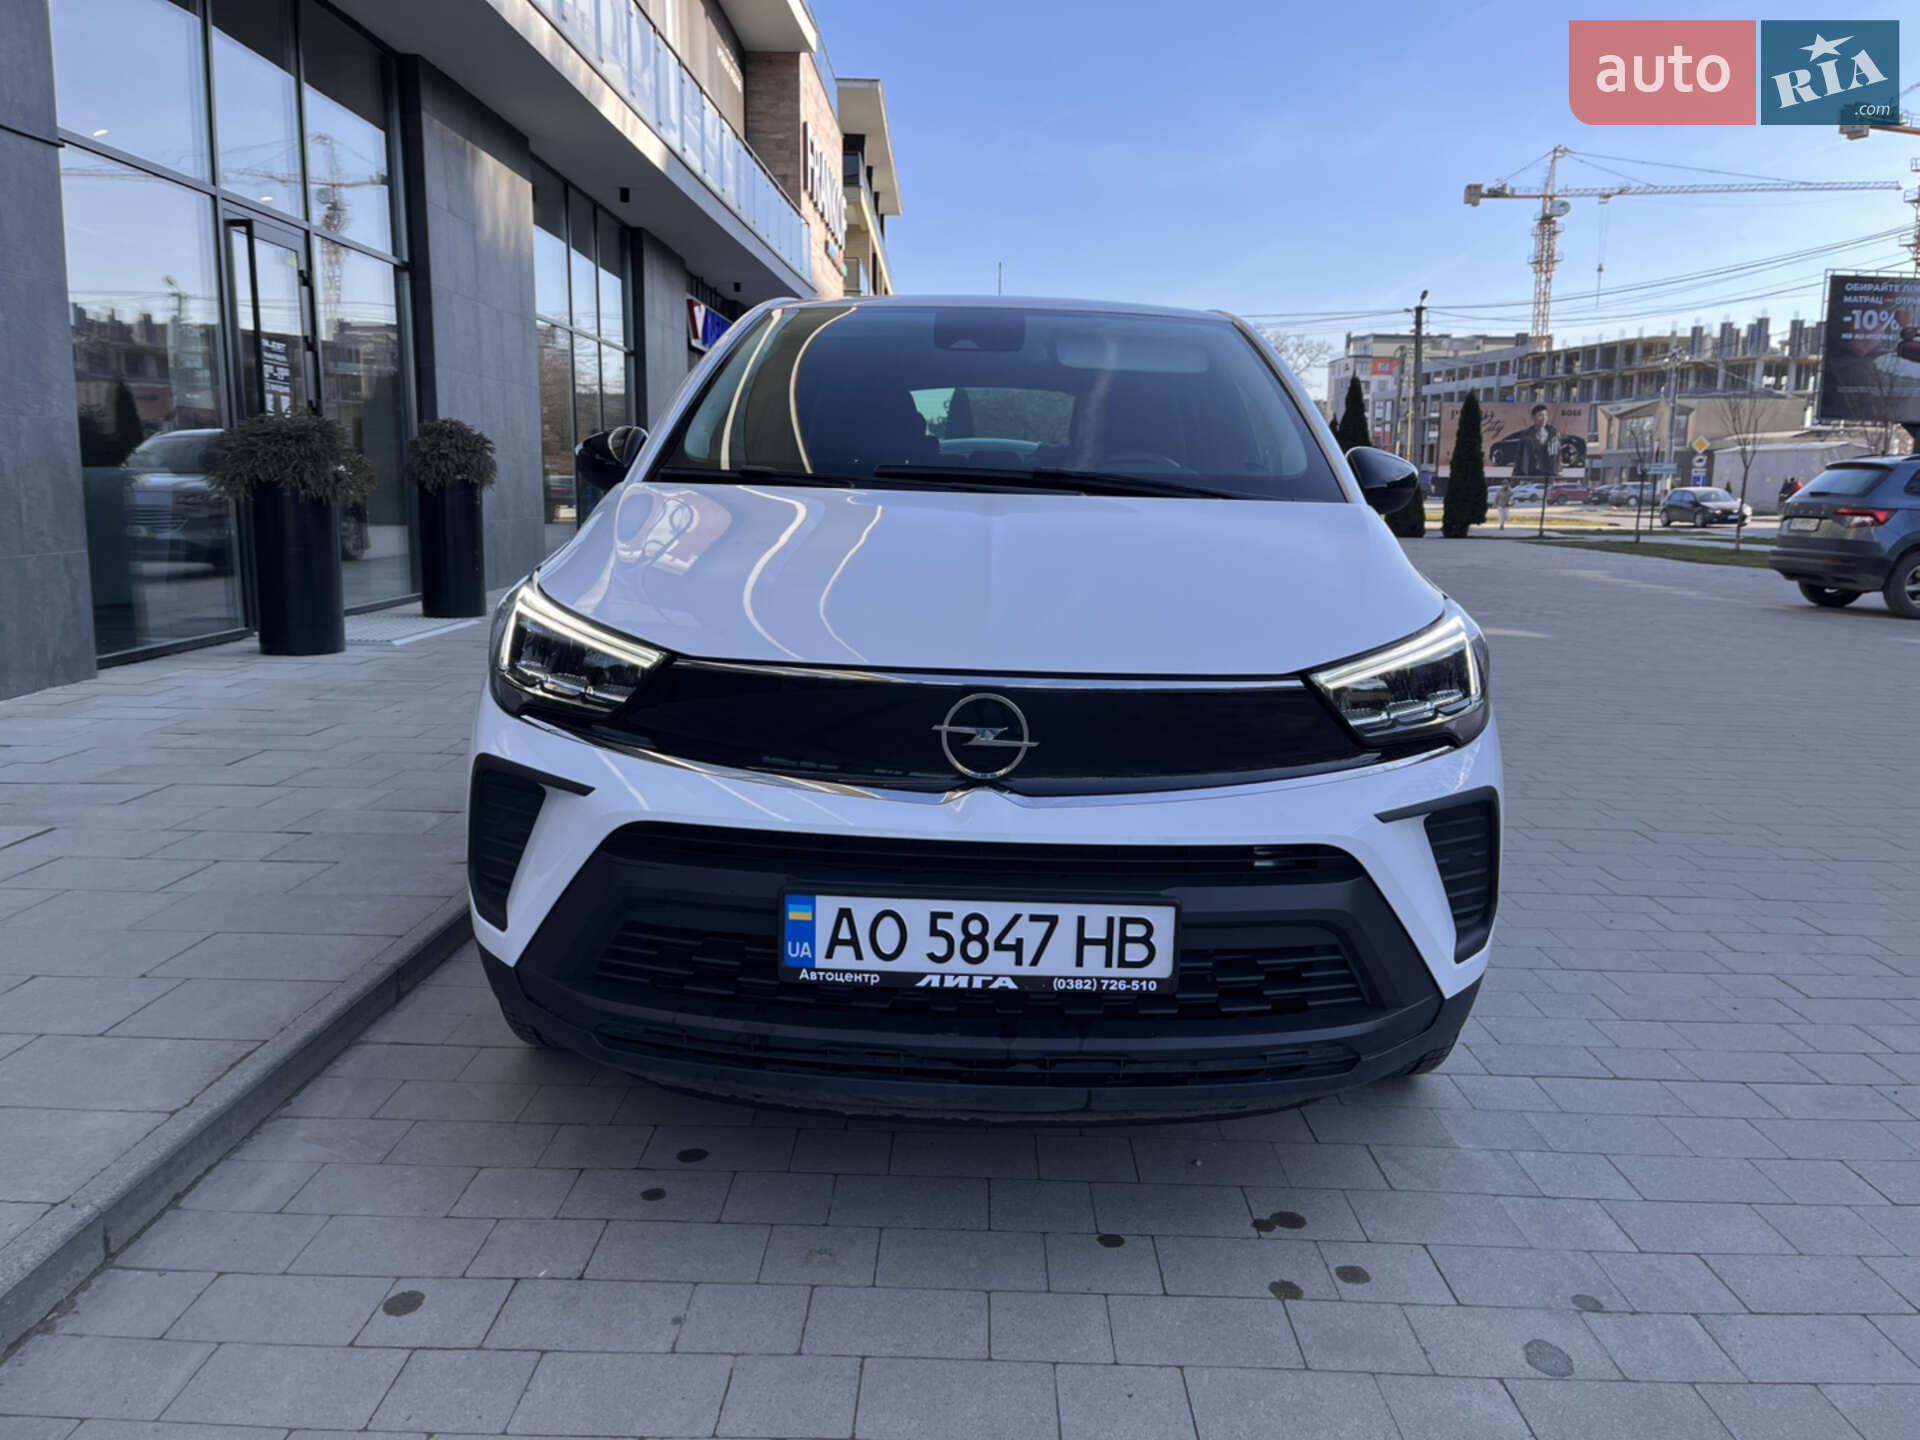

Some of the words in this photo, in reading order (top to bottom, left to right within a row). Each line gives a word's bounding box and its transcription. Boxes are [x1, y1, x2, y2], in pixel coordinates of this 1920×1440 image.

[1842, 309, 1900, 331] -10%
[788, 941, 813, 959] UA
[926, 911, 1060, 967] 5847
[799, 968, 881, 986] Автоцентр
[915, 974, 1019, 990] ЛИГА
[1053, 977, 1098, 992] (0382)
[1100, 979, 1158, 992] 726-510
